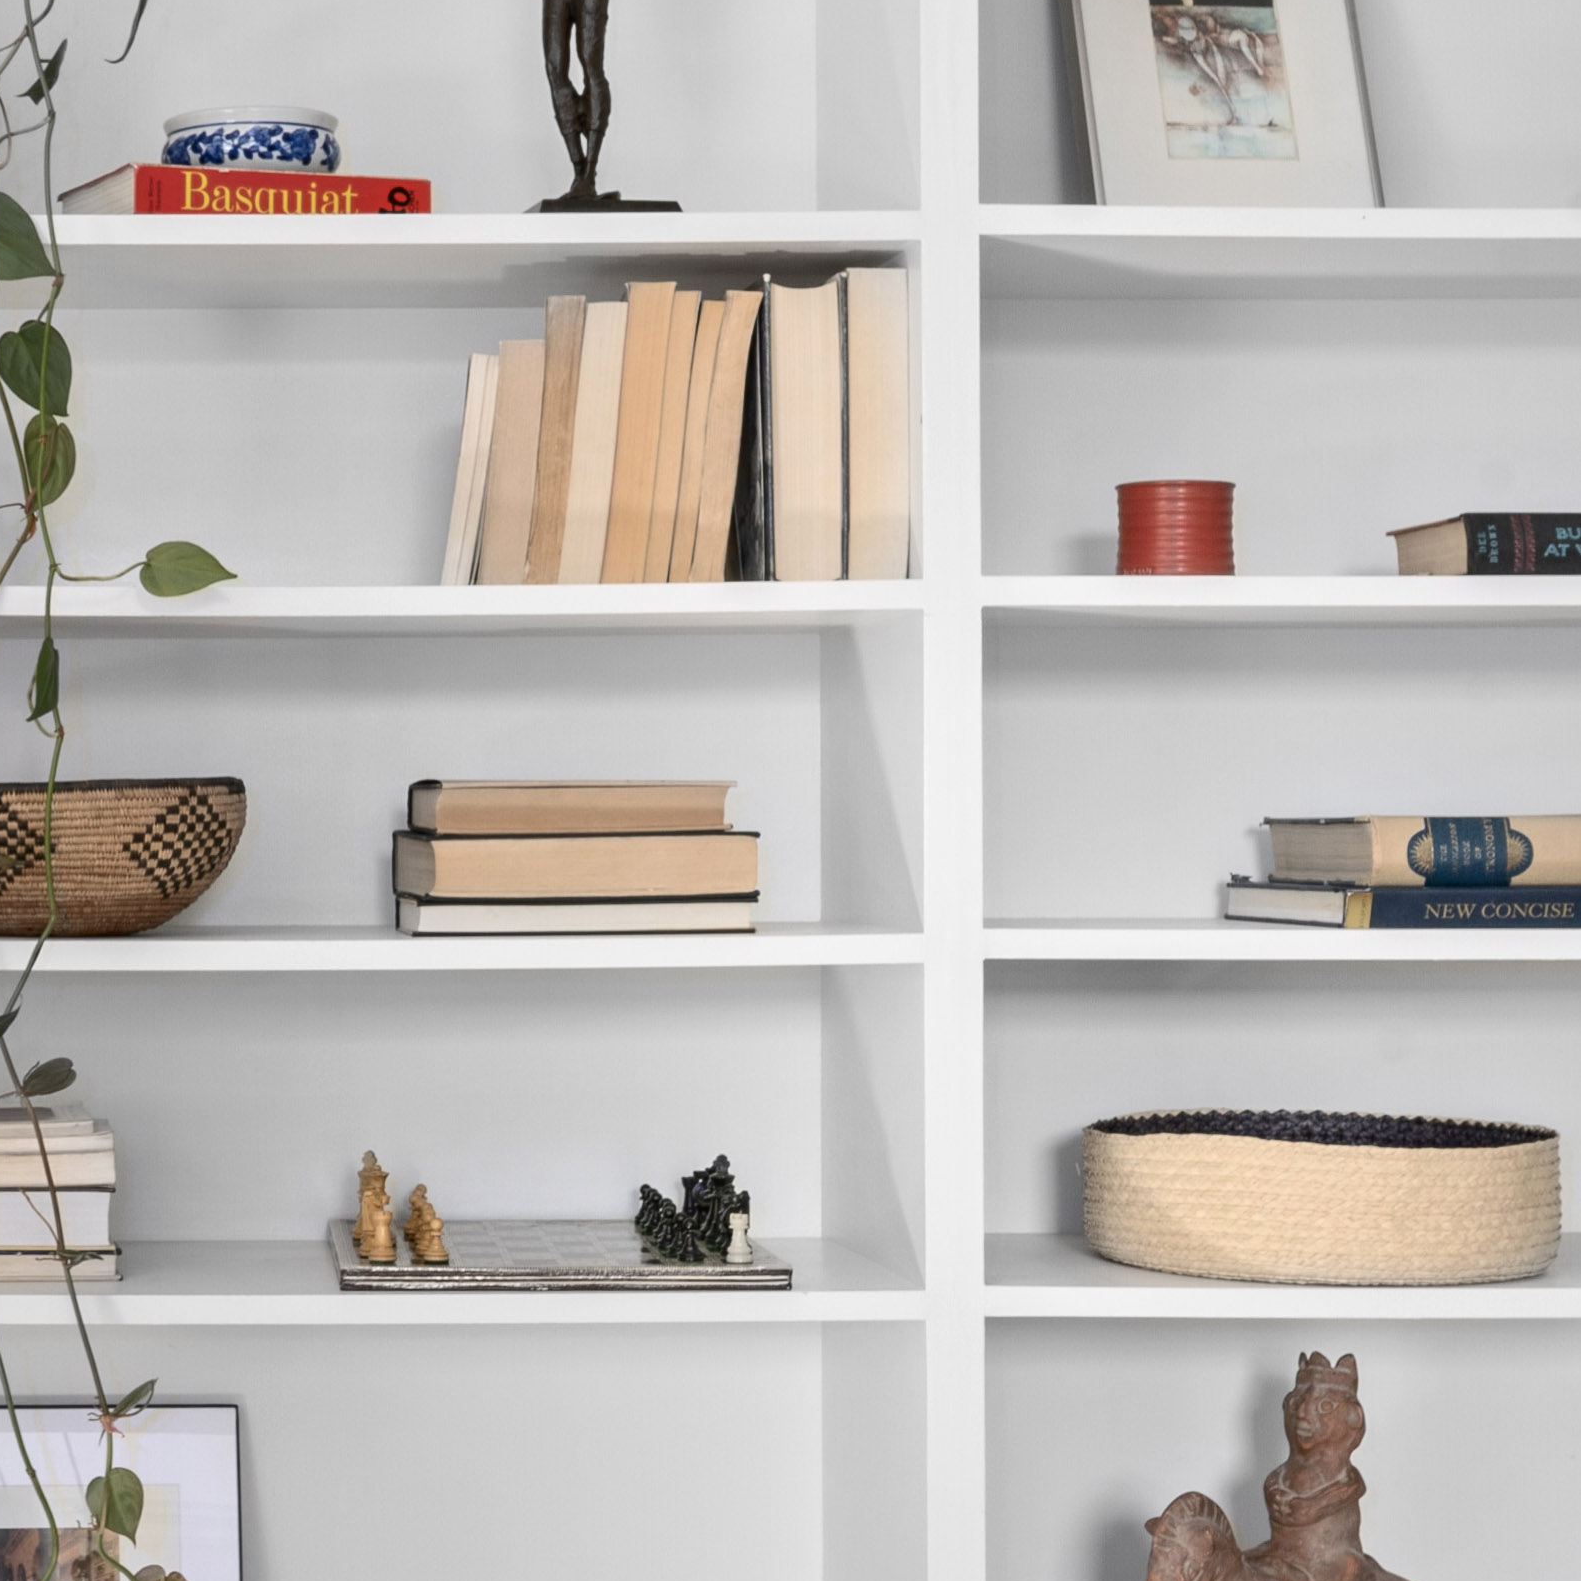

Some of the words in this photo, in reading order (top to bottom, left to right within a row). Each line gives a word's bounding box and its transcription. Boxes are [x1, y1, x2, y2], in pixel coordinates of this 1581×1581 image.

[180, 170, 359, 215] Basquiat
[1478, 532, 1487, 553] DEE
[1544, 543, 1570, 557] AT
[1424, 903, 1467, 919] NEW
[1480, 902, 1575, 919] CONCISE
